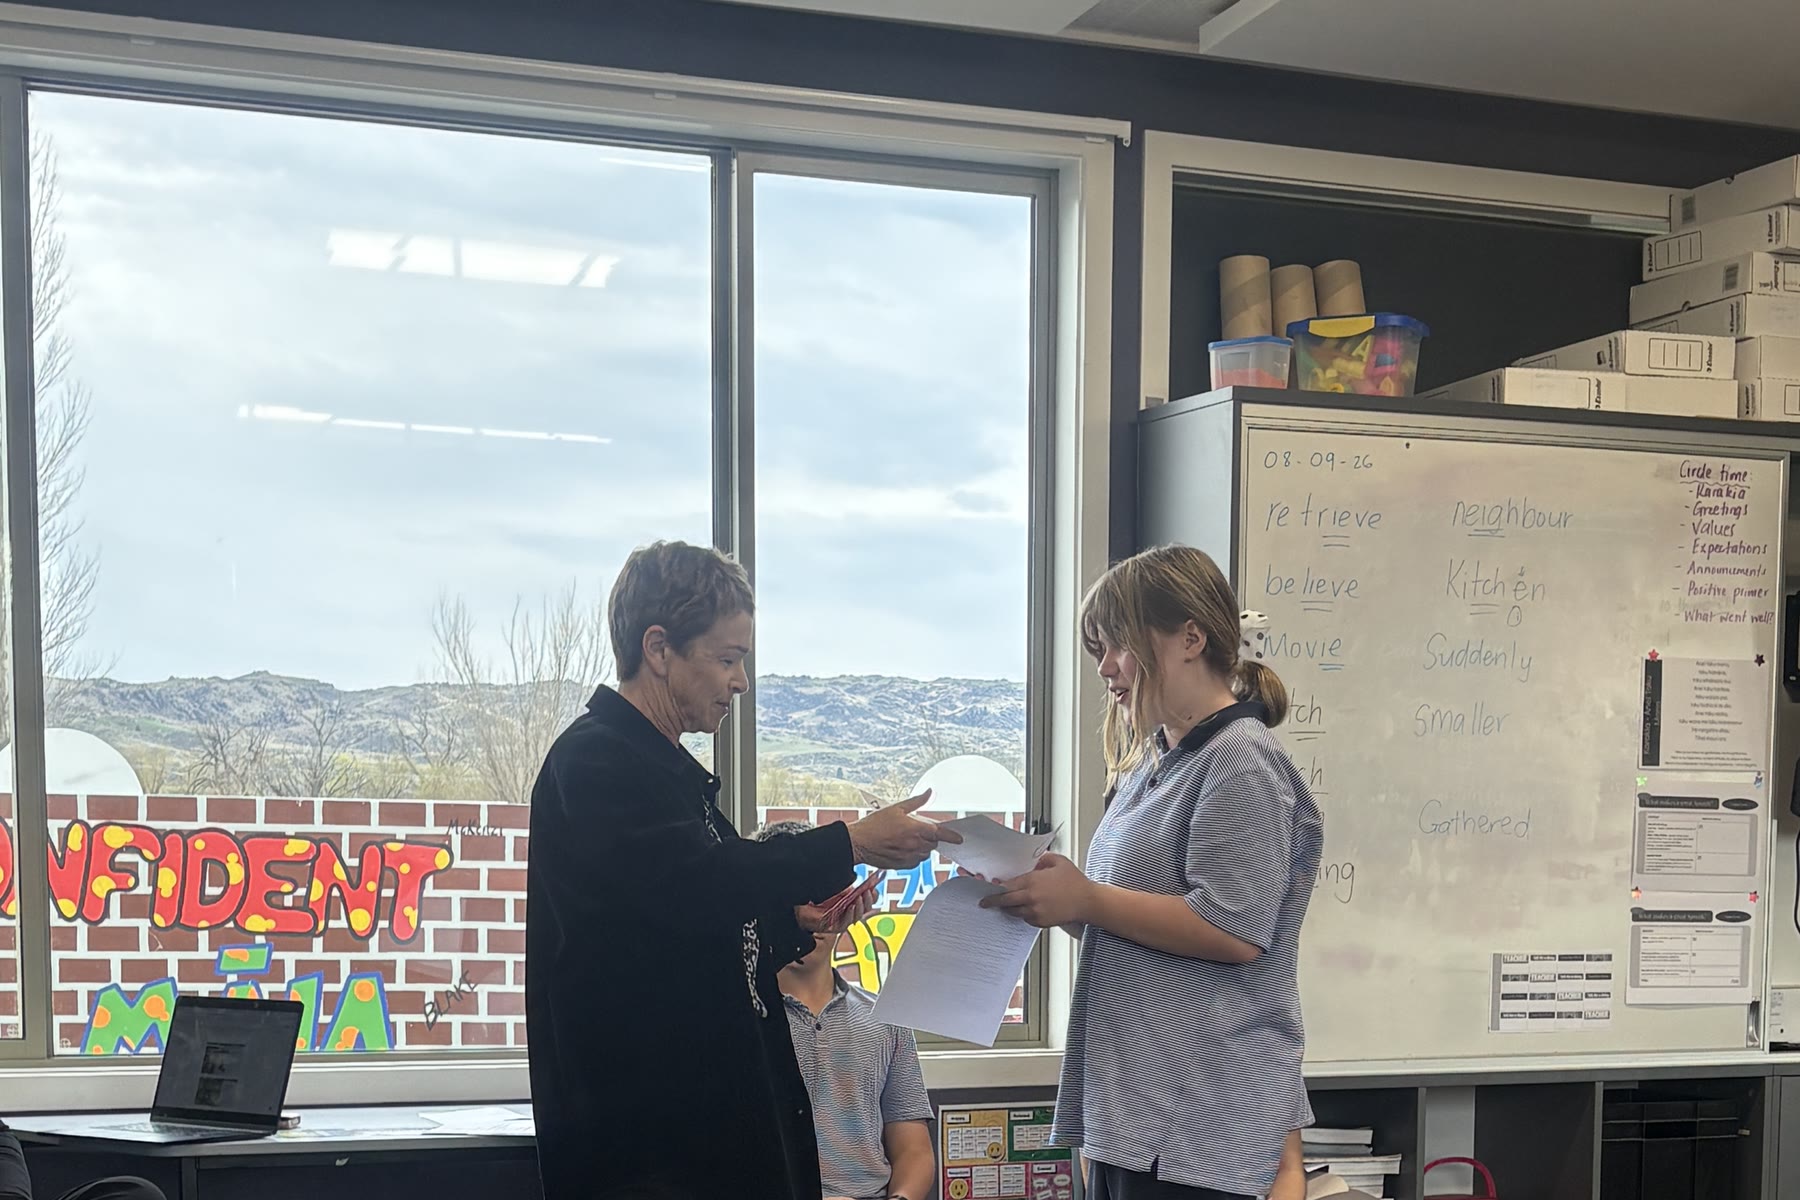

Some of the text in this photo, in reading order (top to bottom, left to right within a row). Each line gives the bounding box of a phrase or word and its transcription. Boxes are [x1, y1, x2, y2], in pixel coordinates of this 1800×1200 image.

[1679, 459, 1711, 479] Circle
[1265, 492, 1382, 531] retrieve
[1452, 496, 1574, 535] neighbour
[1692, 500, 1749, 520] Greetings
[1692, 519, 1736, 537] Values
[1692, 537, 1768, 561] Expectations
[1265, 563, 1360, 599] believe
[1446, 558, 1546, 601] Kitchen
[1687, 580, 1727, 597] Positive
[1684, 608, 1714, 623] What
[1262, 632, 1342, 659] Movie
[1422, 632, 1533, 683] Suddenly
[1287, 687, 1323, 726] tch
[1413, 701, 1511, 737] Smaller
[1418, 799, 1532, 840] Gathered
[1317, 862, 1355, 904] ing
[424, 969, 479, 1032] BLAKE
